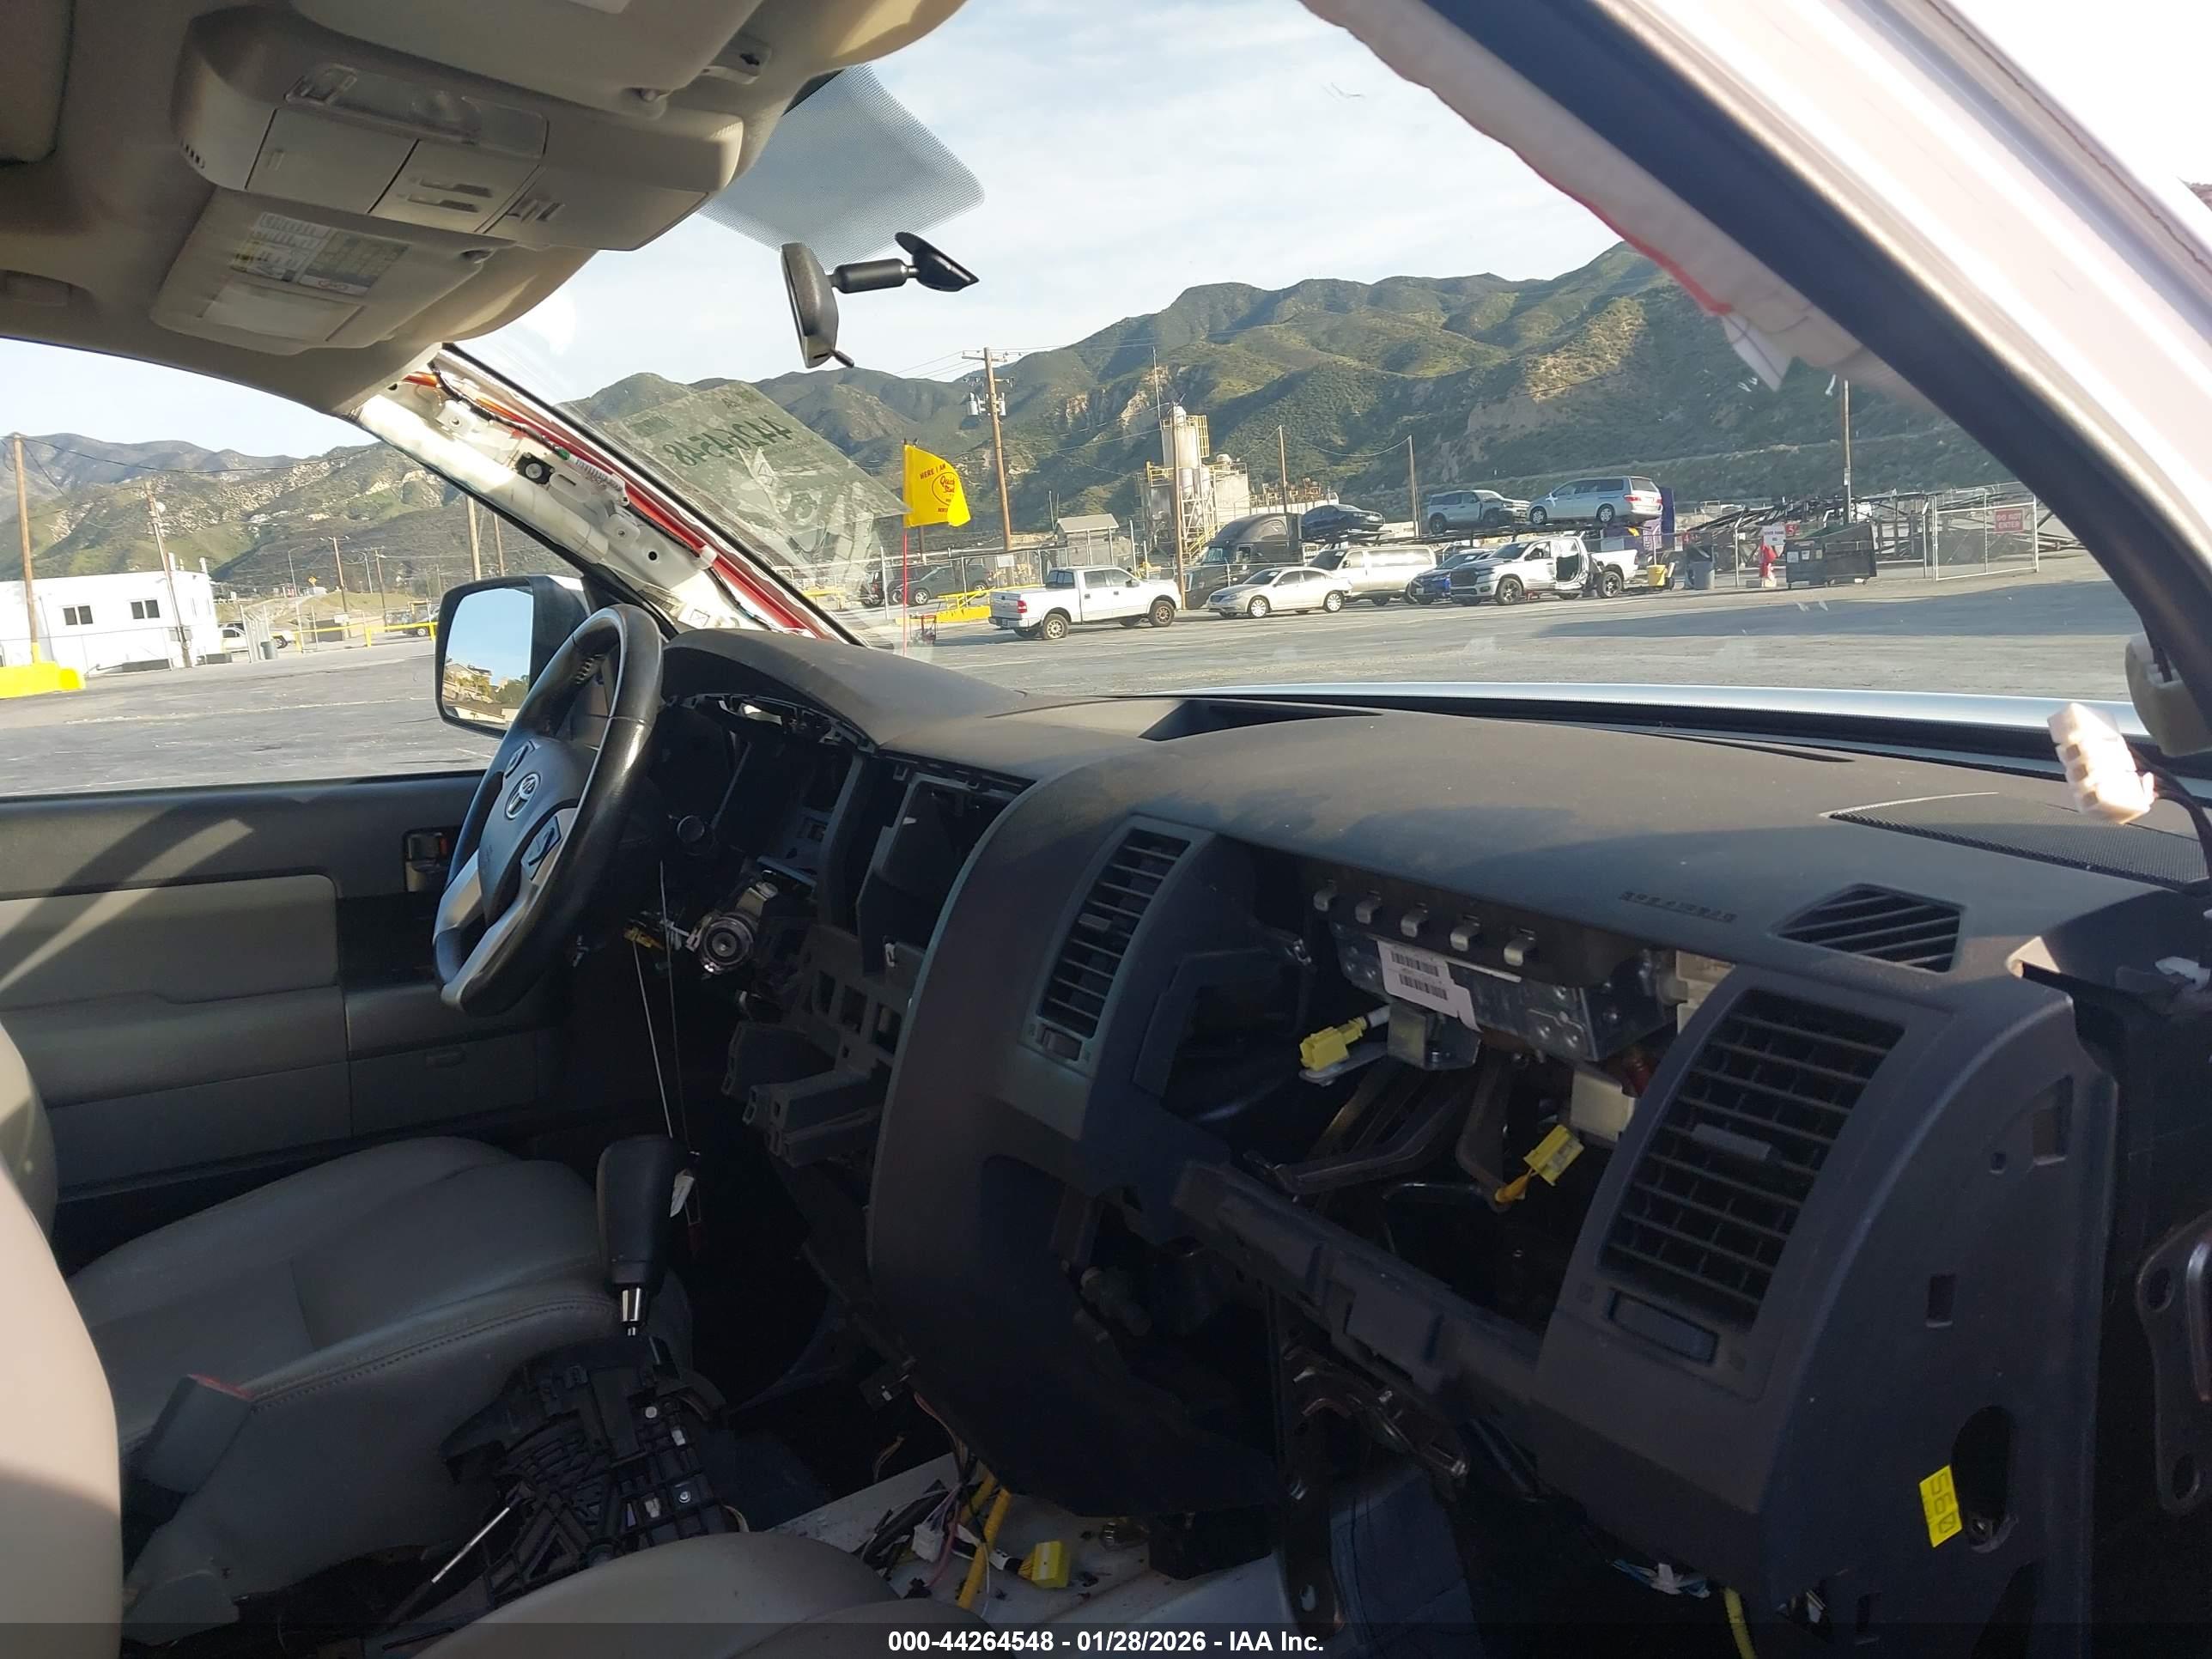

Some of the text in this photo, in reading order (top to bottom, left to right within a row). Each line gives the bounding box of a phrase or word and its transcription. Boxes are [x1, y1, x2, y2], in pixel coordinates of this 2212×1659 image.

[919, 468, 935, 480] HERE
[2008, 513, 2021, 521] NOT
[1998, 520, 2021, 529] ENTER
